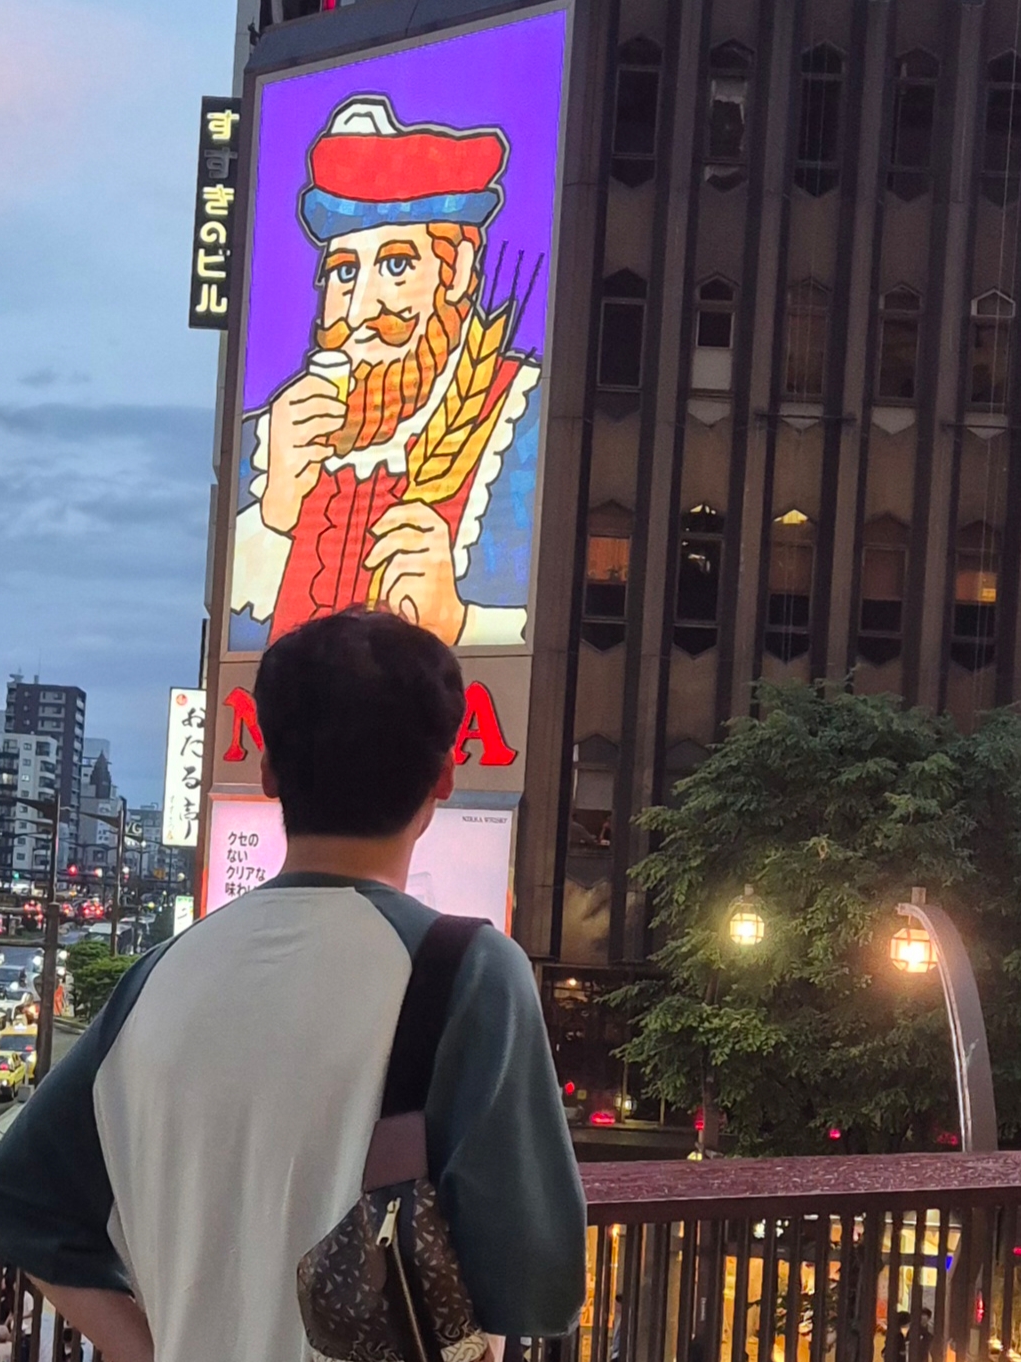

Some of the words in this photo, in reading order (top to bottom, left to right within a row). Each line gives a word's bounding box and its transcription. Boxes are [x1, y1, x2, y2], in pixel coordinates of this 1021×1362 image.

[227, 831, 259, 847] クセの
[226, 848, 248, 863] ない
[226, 866, 266, 882] クリアな
